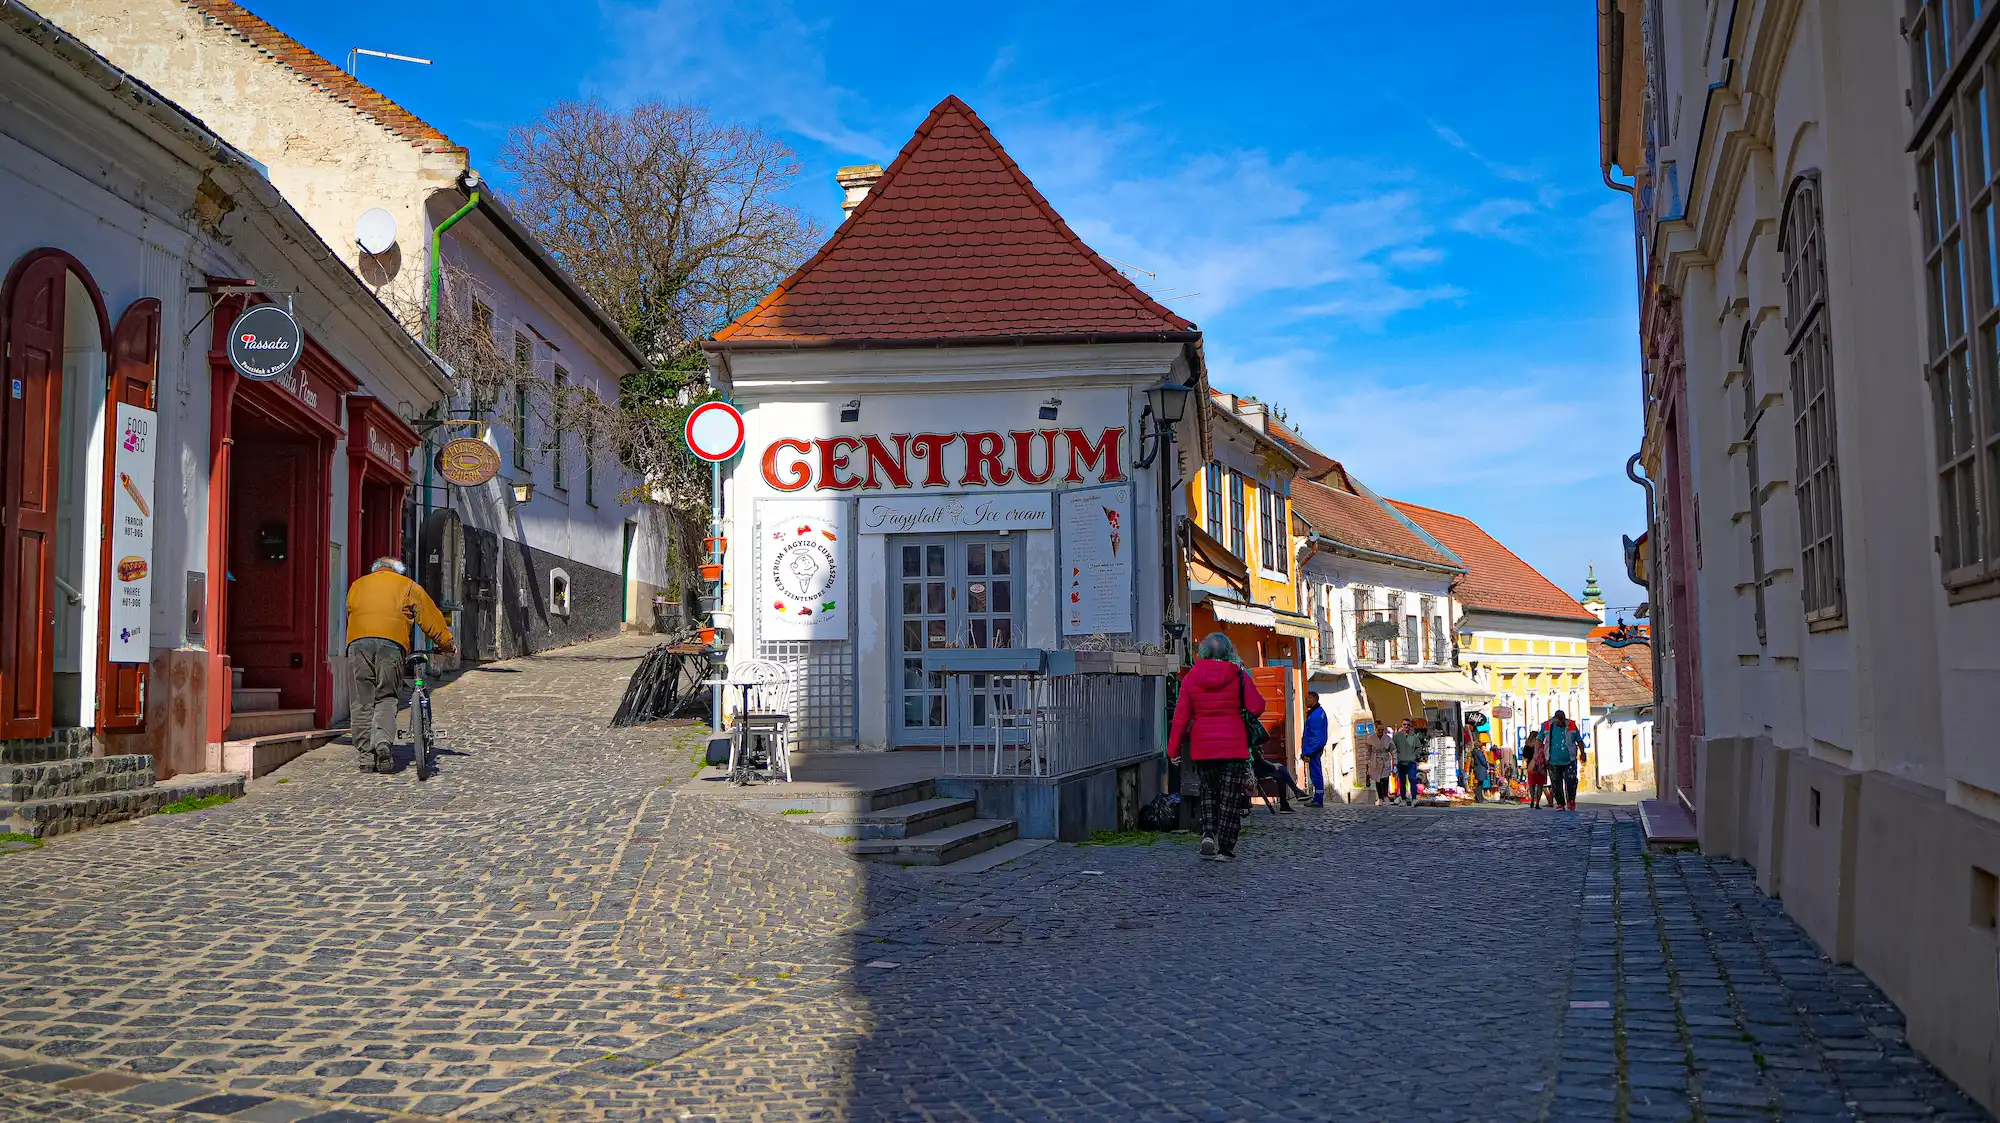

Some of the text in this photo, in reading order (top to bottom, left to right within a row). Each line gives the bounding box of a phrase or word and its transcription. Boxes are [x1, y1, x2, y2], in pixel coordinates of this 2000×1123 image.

[241, 334, 290, 350] Passata
[298, 369, 318, 409] Pizza
[127, 417, 148, 436] FOOD
[135, 436, 146, 452] GO
[759, 427, 1128, 492] CENTRUM
[124, 515, 144, 527] FRANCIA
[864, 505, 947, 532] Fagylalt
[962, 500, 1001, 526] Ice
[1004, 508, 1049, 522] cream
[124, 527, 144, 538] HOT-DOG
[773, 540, 838, 592] CENTRUM FAGYIZÓ CUKRÁSZDA
[122, 597, 141, 608] HOT-DOG
[784, 589, 827, 602] SZENTENDRE
